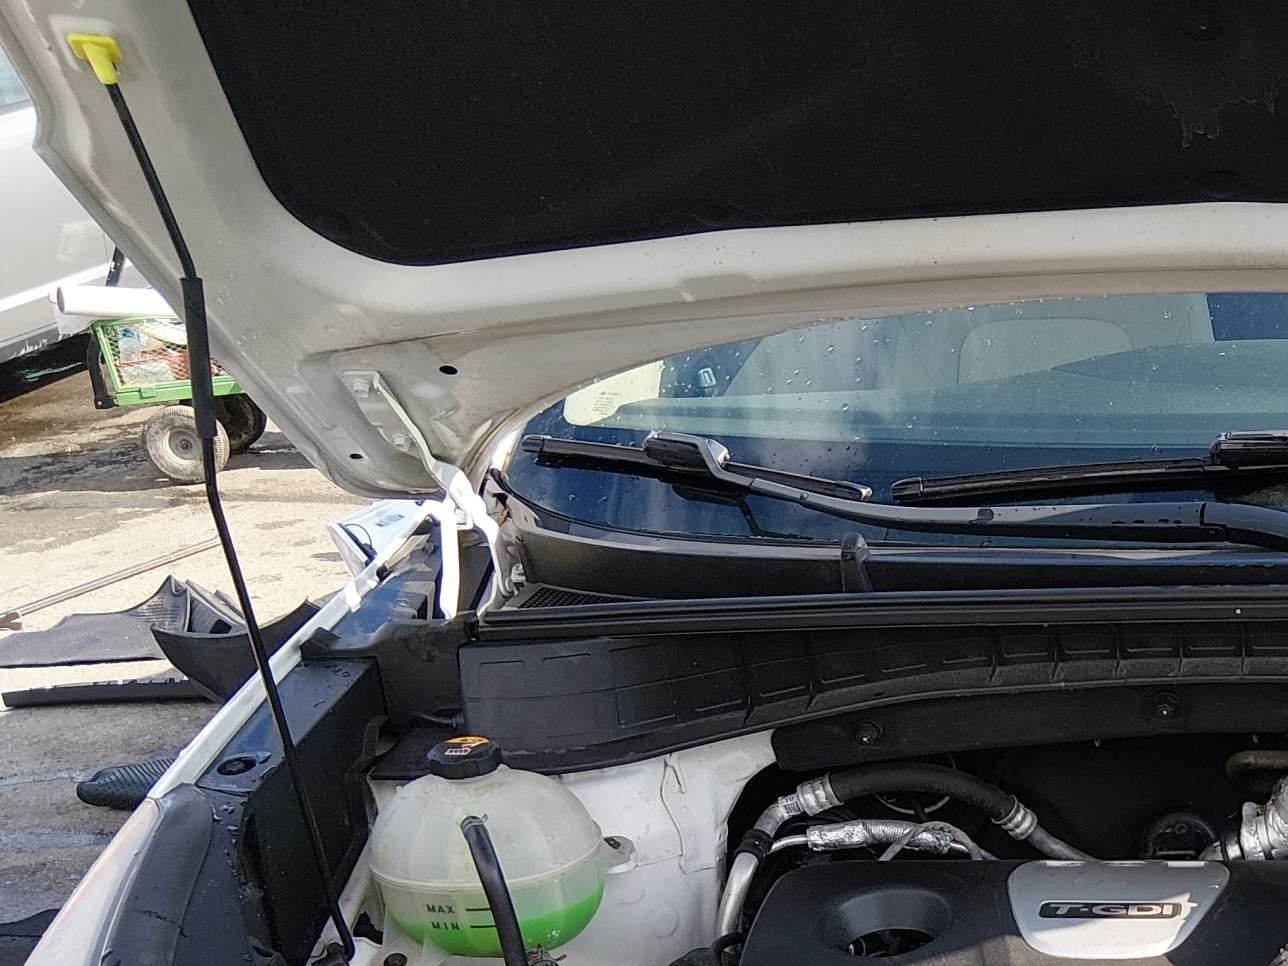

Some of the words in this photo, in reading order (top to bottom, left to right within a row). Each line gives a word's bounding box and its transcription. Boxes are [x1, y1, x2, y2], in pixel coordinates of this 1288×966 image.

[426, 904, 455, 914] MAX
[1050, 903, 1173, 916] T-GDI
[431, 921, 460, 931] MIN
